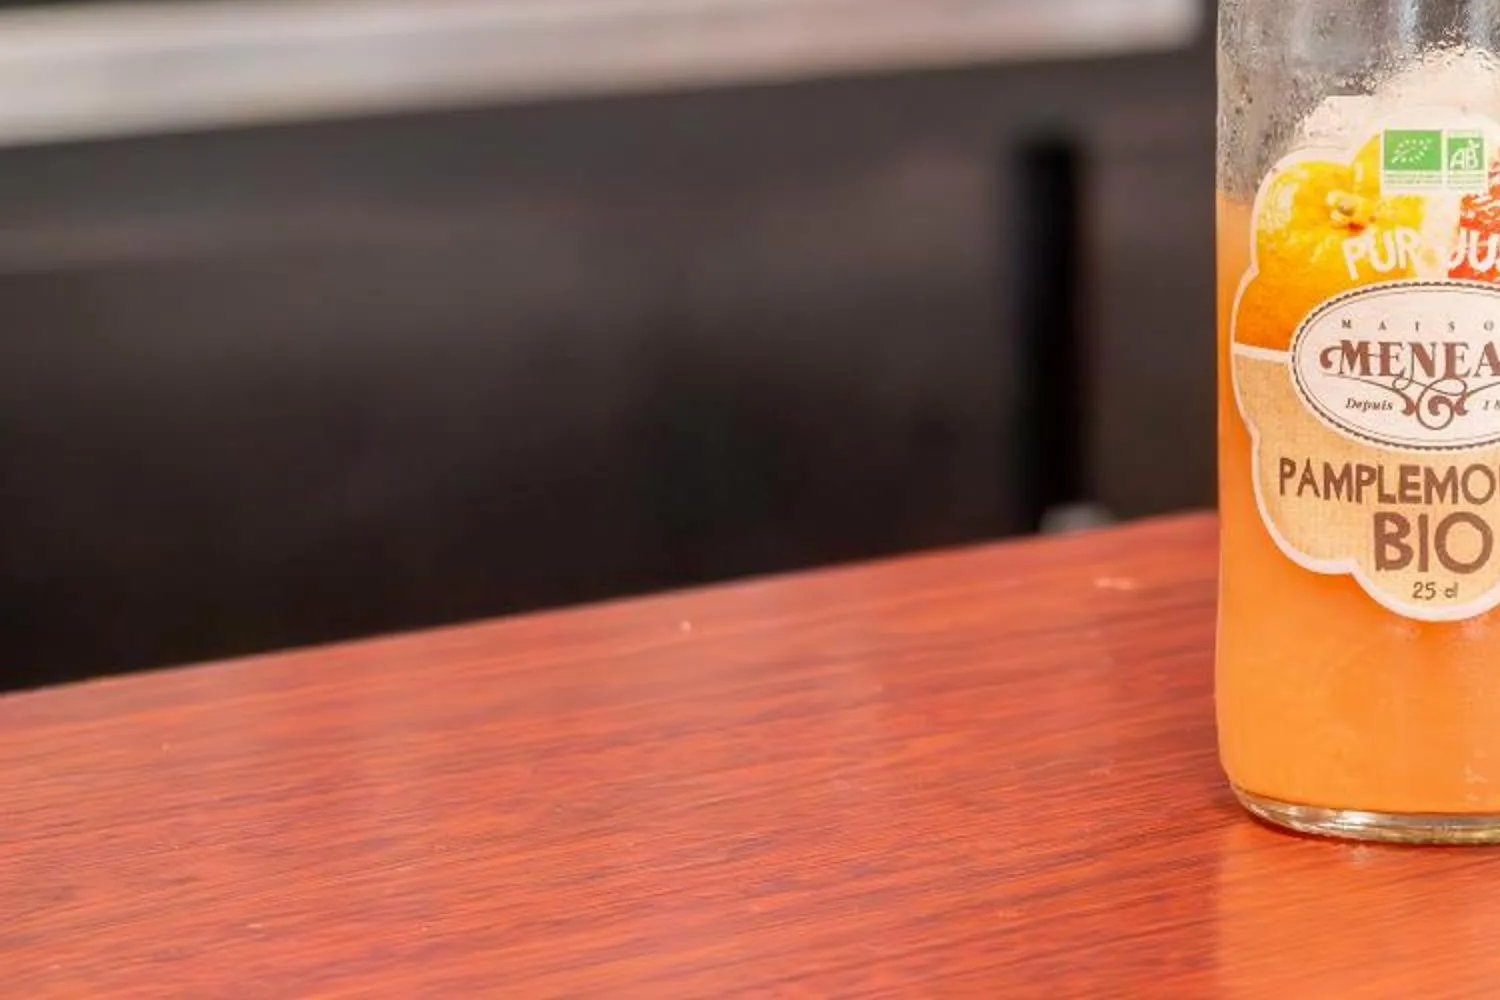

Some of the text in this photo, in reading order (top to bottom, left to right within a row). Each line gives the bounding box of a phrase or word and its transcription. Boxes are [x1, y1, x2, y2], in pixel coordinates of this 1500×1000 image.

[1342, 225, 1421, 280] PUR
[1345, 397, 1394, 413] Depuis
[1373, 510, 1494, 575] BIO
[1411, 581, 1459, 600] 25 cl
